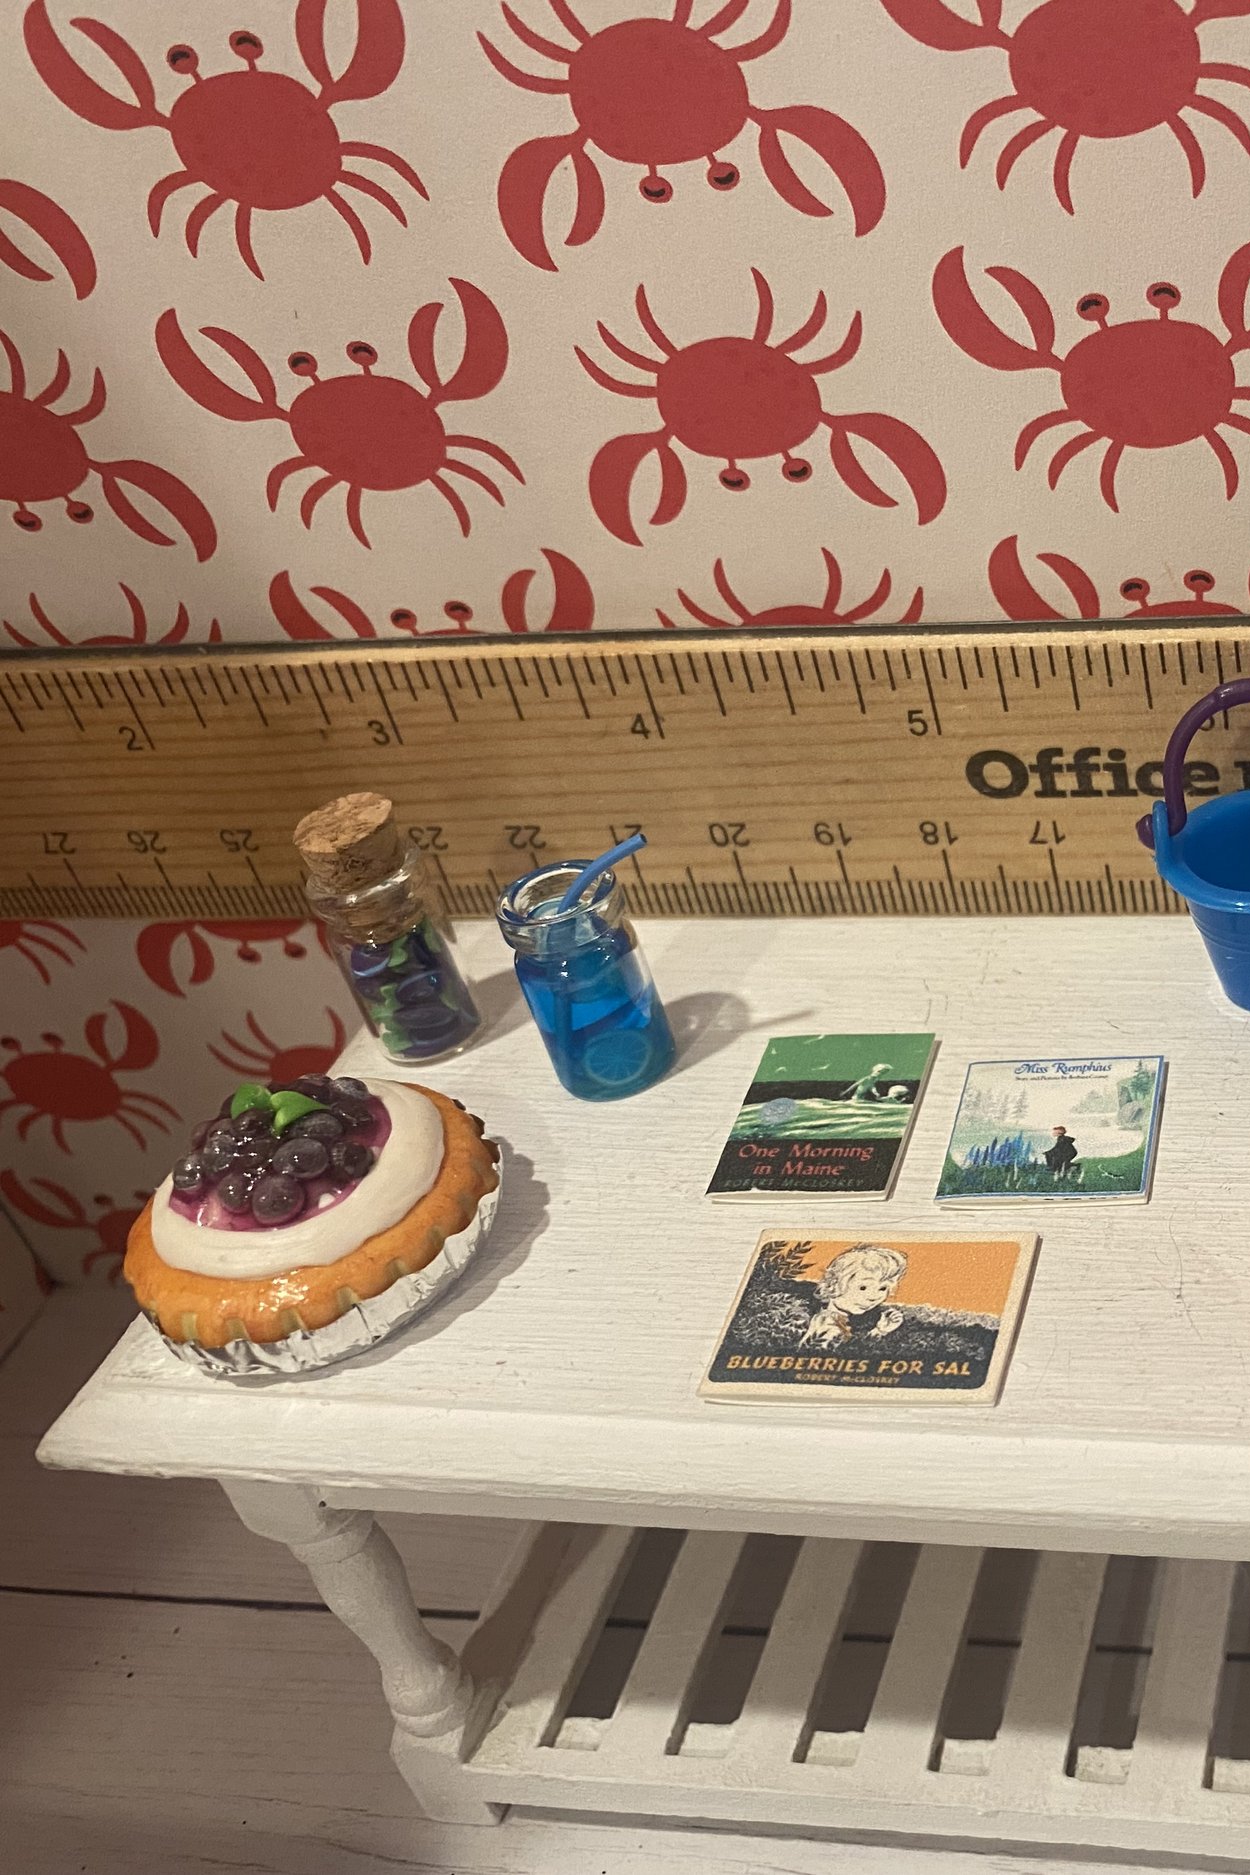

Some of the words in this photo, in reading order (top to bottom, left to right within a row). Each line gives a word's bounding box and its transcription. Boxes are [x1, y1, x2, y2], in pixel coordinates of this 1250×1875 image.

[118, 726, 143, 752] 2
[367, 720, 391, 746] 3
[631, 713, 651, 739] 4
[907, 709, 929, 737] 5
[965, 746, 1220, 799] Office
[709, 822, 751, 848] 20
[919, 820, 959, 847] 18
[1028, 820, 1066, 846] 17
[1014, 1062, 1048, 1075] Miss
[1052, 1061, 1112, 1075] Rumphius
[738, 1143, 780, 1158] One
[788, 1142, 875, 1161] Morning
[752, 1162, 772, 1175] in
[781, 1160, 846, 1176] Maine
[726, 1355, 869, 1373] BLUEBERRIES
[877, 1359, 923, 1375] FOR
[932, 1361, 971, 1376] SAL
